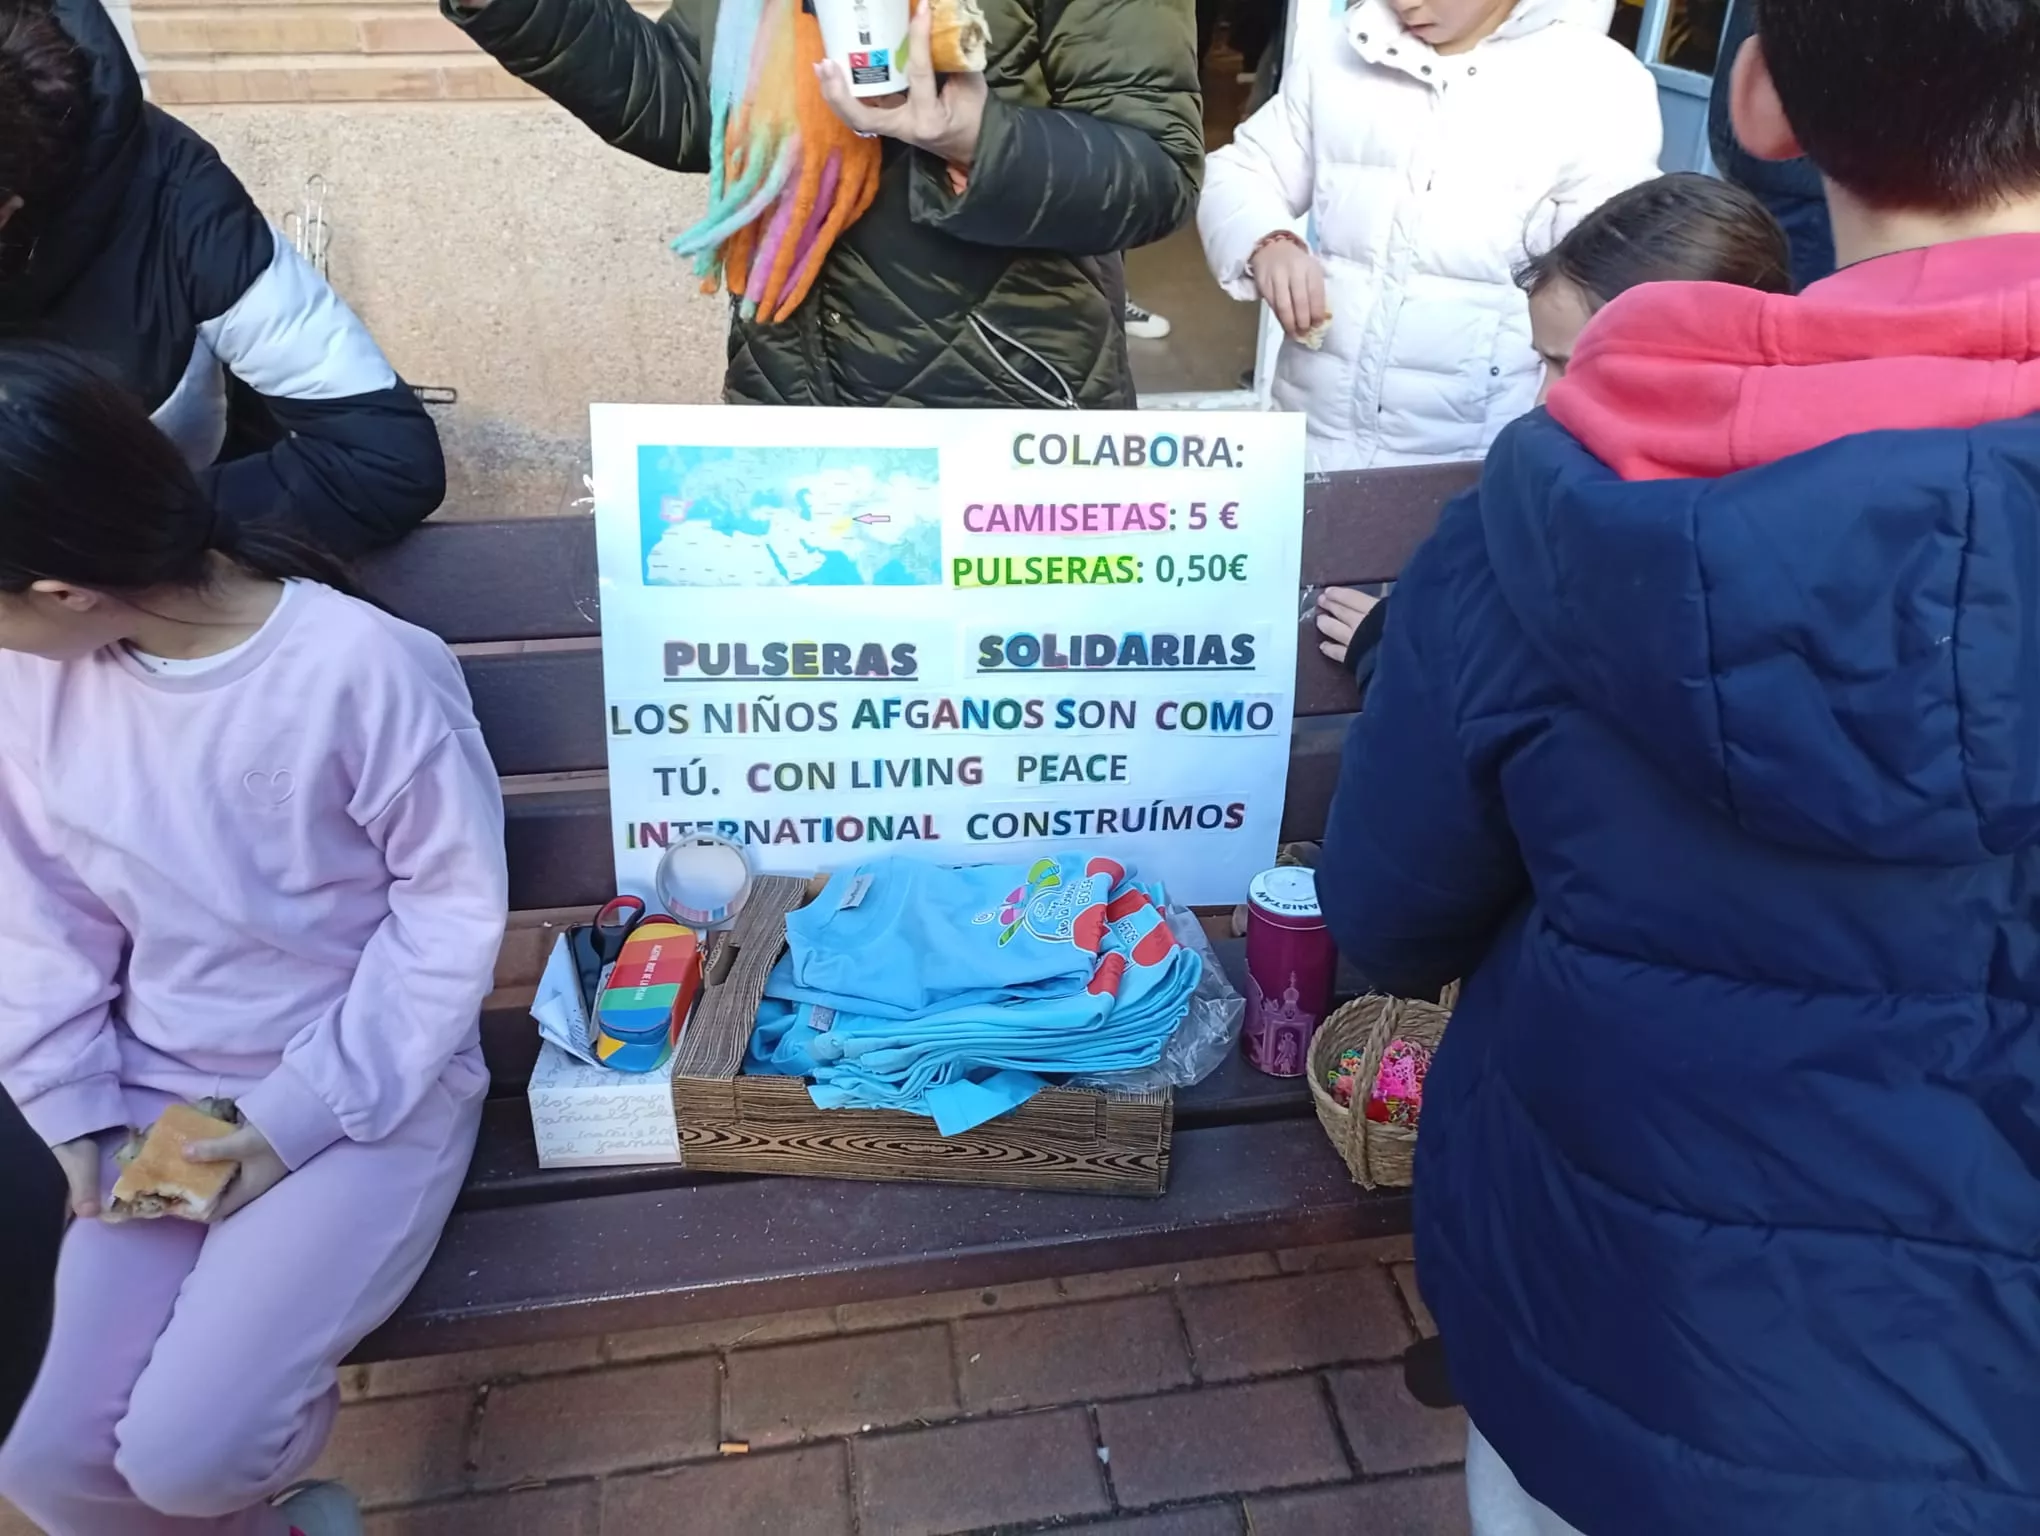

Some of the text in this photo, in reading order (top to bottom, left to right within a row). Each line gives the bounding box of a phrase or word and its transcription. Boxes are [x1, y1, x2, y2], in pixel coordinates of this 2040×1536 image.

[1012, 432, 1244, 468] COLABORA:
[962, 501, 1240, 533] CAMISETAS: 5 €
[952, 554, 1248, 587] PULSERAS: 0,50€
[663, 632, 1256, 677] PULSERAS SOLIDARIAS
[610, 695, 1275, 735] LOS NIÑOS AFGANOS SON COMO
[652, 754, 1128, 797] TÚ. CON LIVING PEACE
[966, 800, 1246, 840] CONSTRUÍMOS
[1255, 891, 1319, 910] ANISTAN
